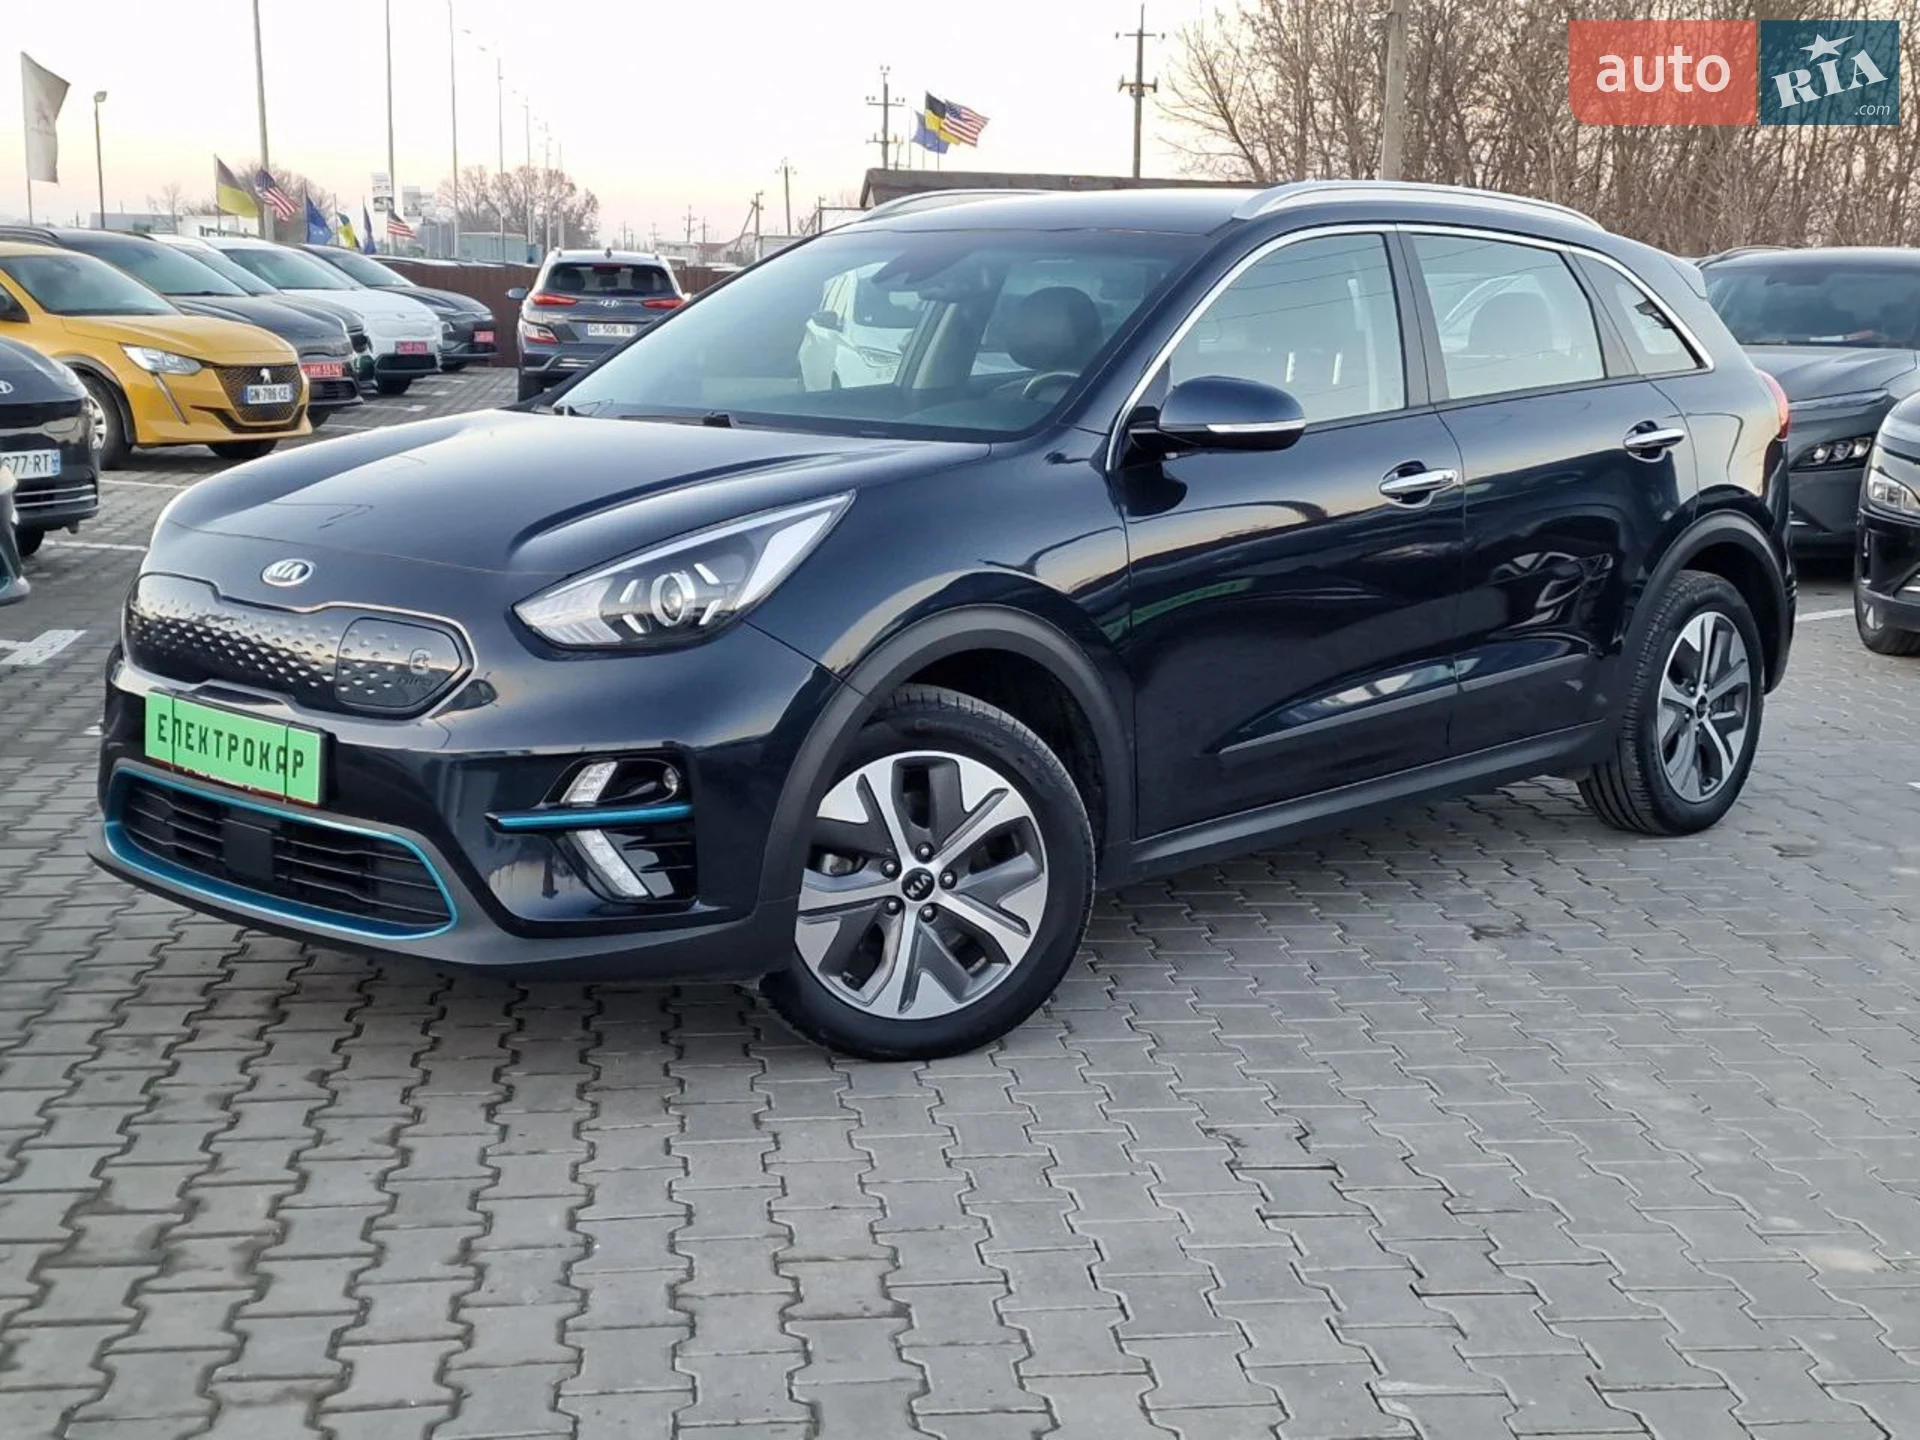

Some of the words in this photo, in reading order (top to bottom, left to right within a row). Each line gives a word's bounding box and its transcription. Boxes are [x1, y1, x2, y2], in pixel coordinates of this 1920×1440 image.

[264, 561, 304, 580] KIA
[156, 712, 305, 780] ЕЛЕКТРОКАР
[906, 873, 933, 898] KIA
